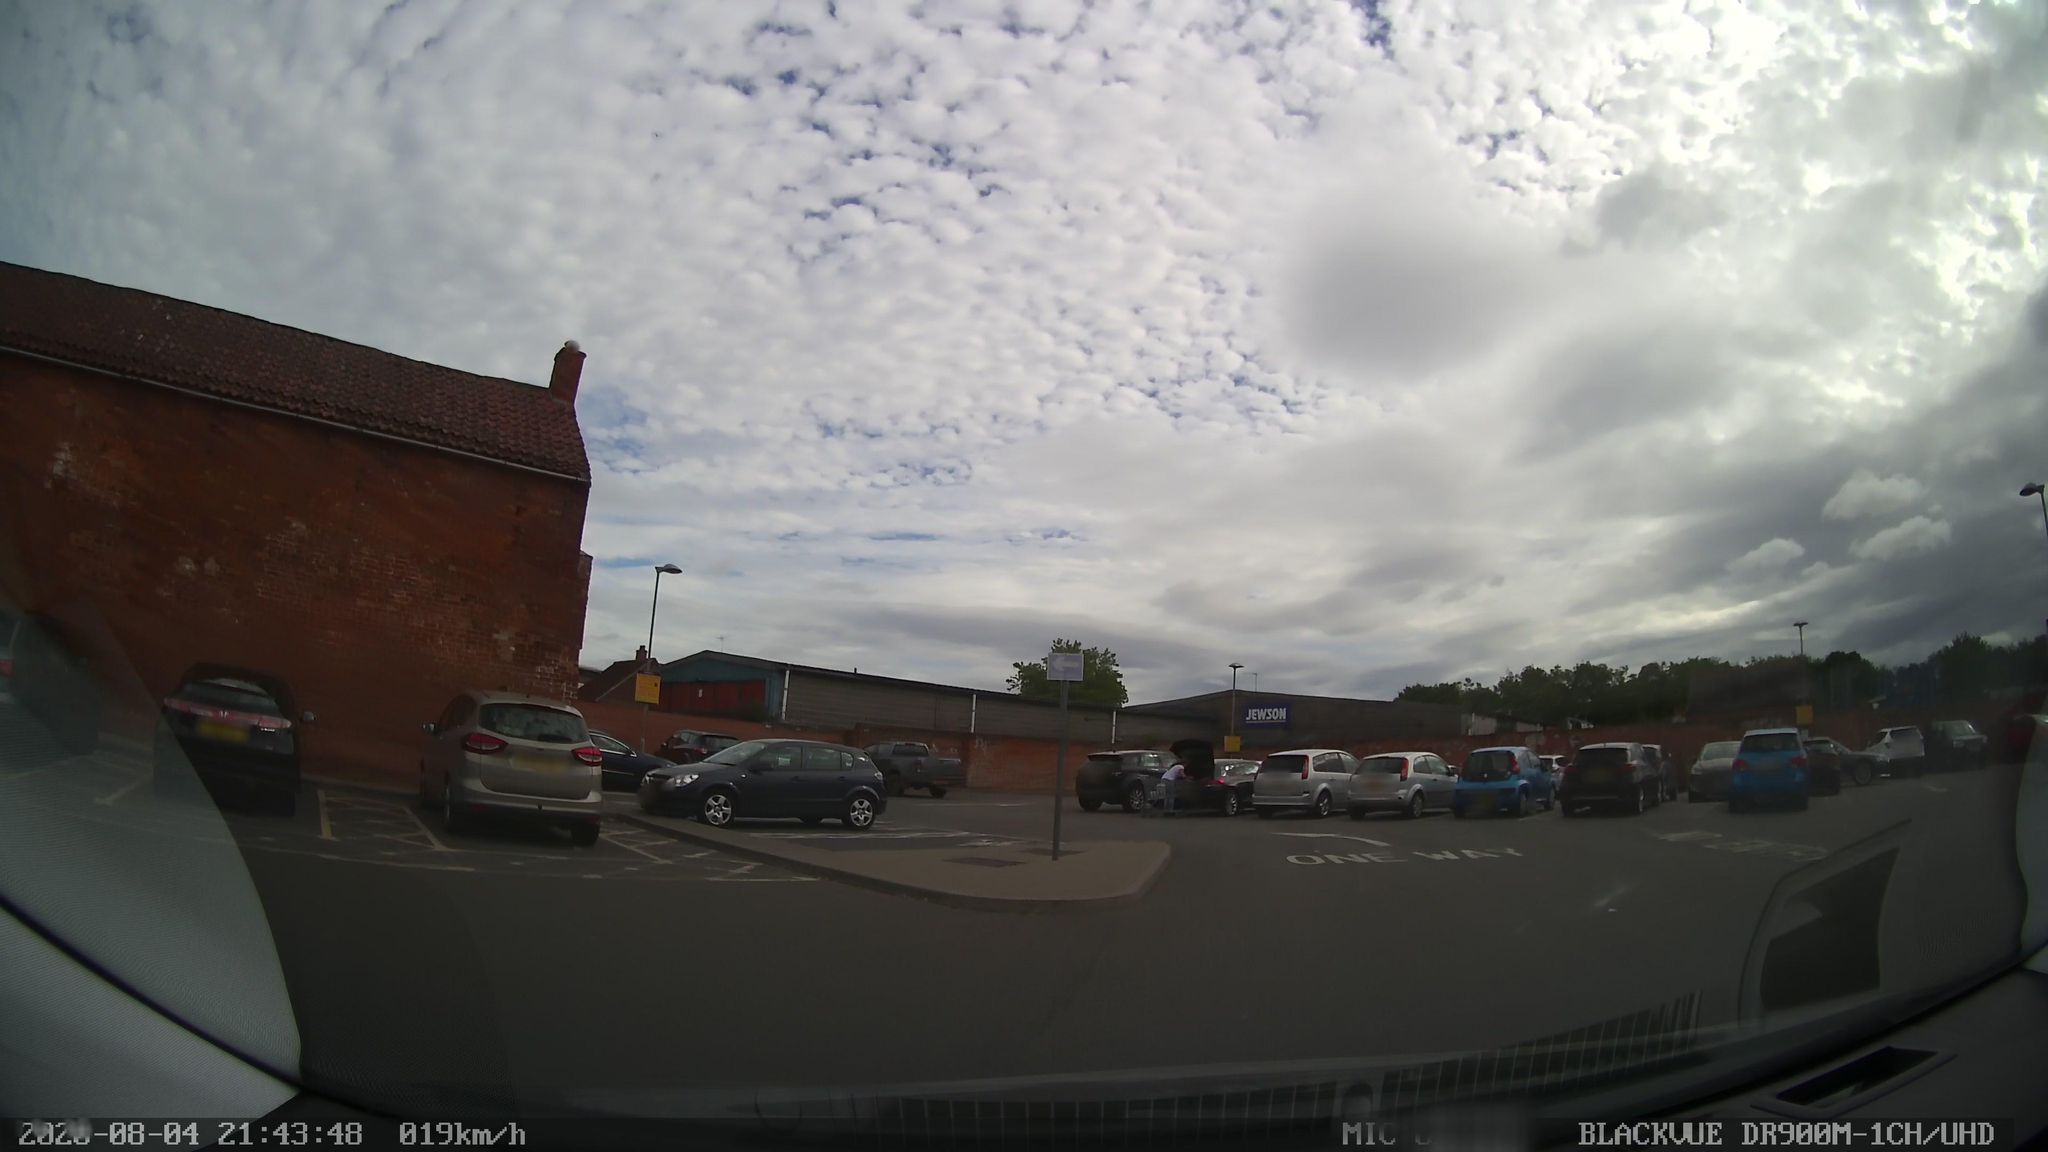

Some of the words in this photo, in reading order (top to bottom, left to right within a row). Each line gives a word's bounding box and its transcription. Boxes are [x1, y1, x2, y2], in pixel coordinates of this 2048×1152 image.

[1246, 708, 1287, 721] JEWSON
[1286, 851, 1409, 865] ONE
[1412, 847, 1523, 860] WAY
